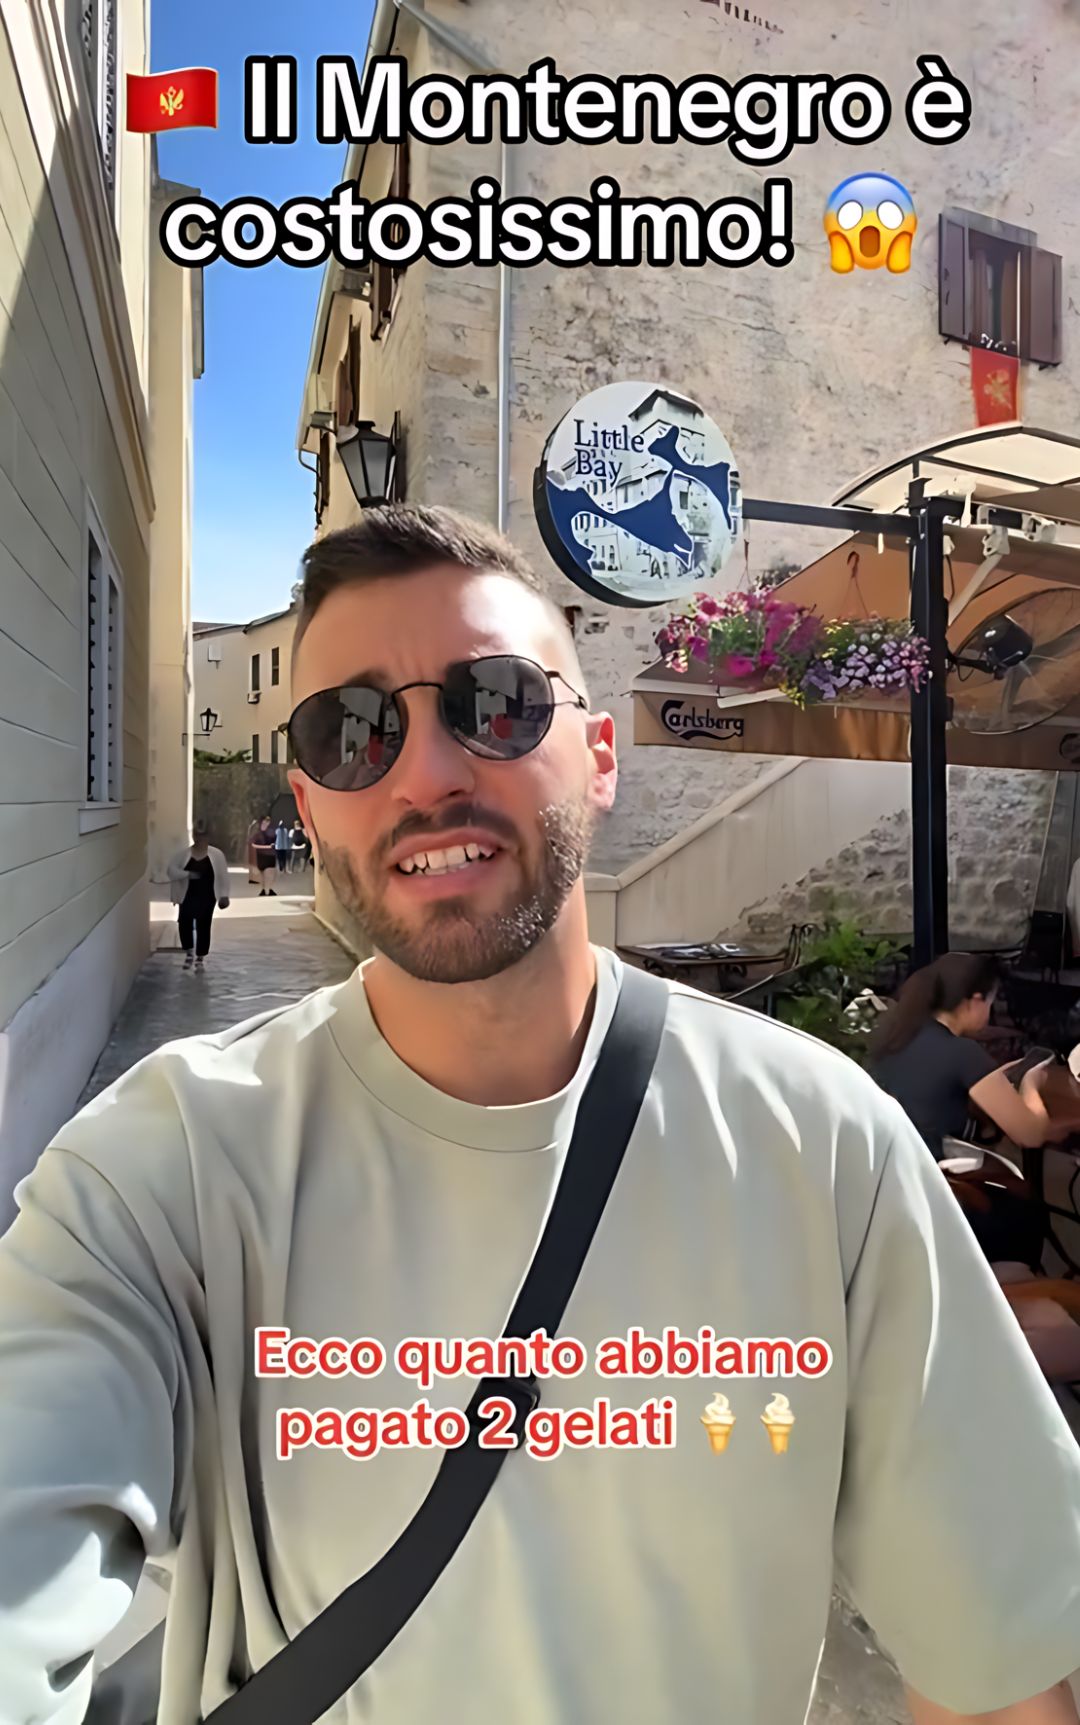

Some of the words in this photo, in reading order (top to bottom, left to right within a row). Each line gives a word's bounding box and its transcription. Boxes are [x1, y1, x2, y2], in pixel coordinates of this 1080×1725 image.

[574, 419, 644, 453] Little
[575, 448, 622, 487] Bay
[661, 700, 744, 739] Carlsberg
